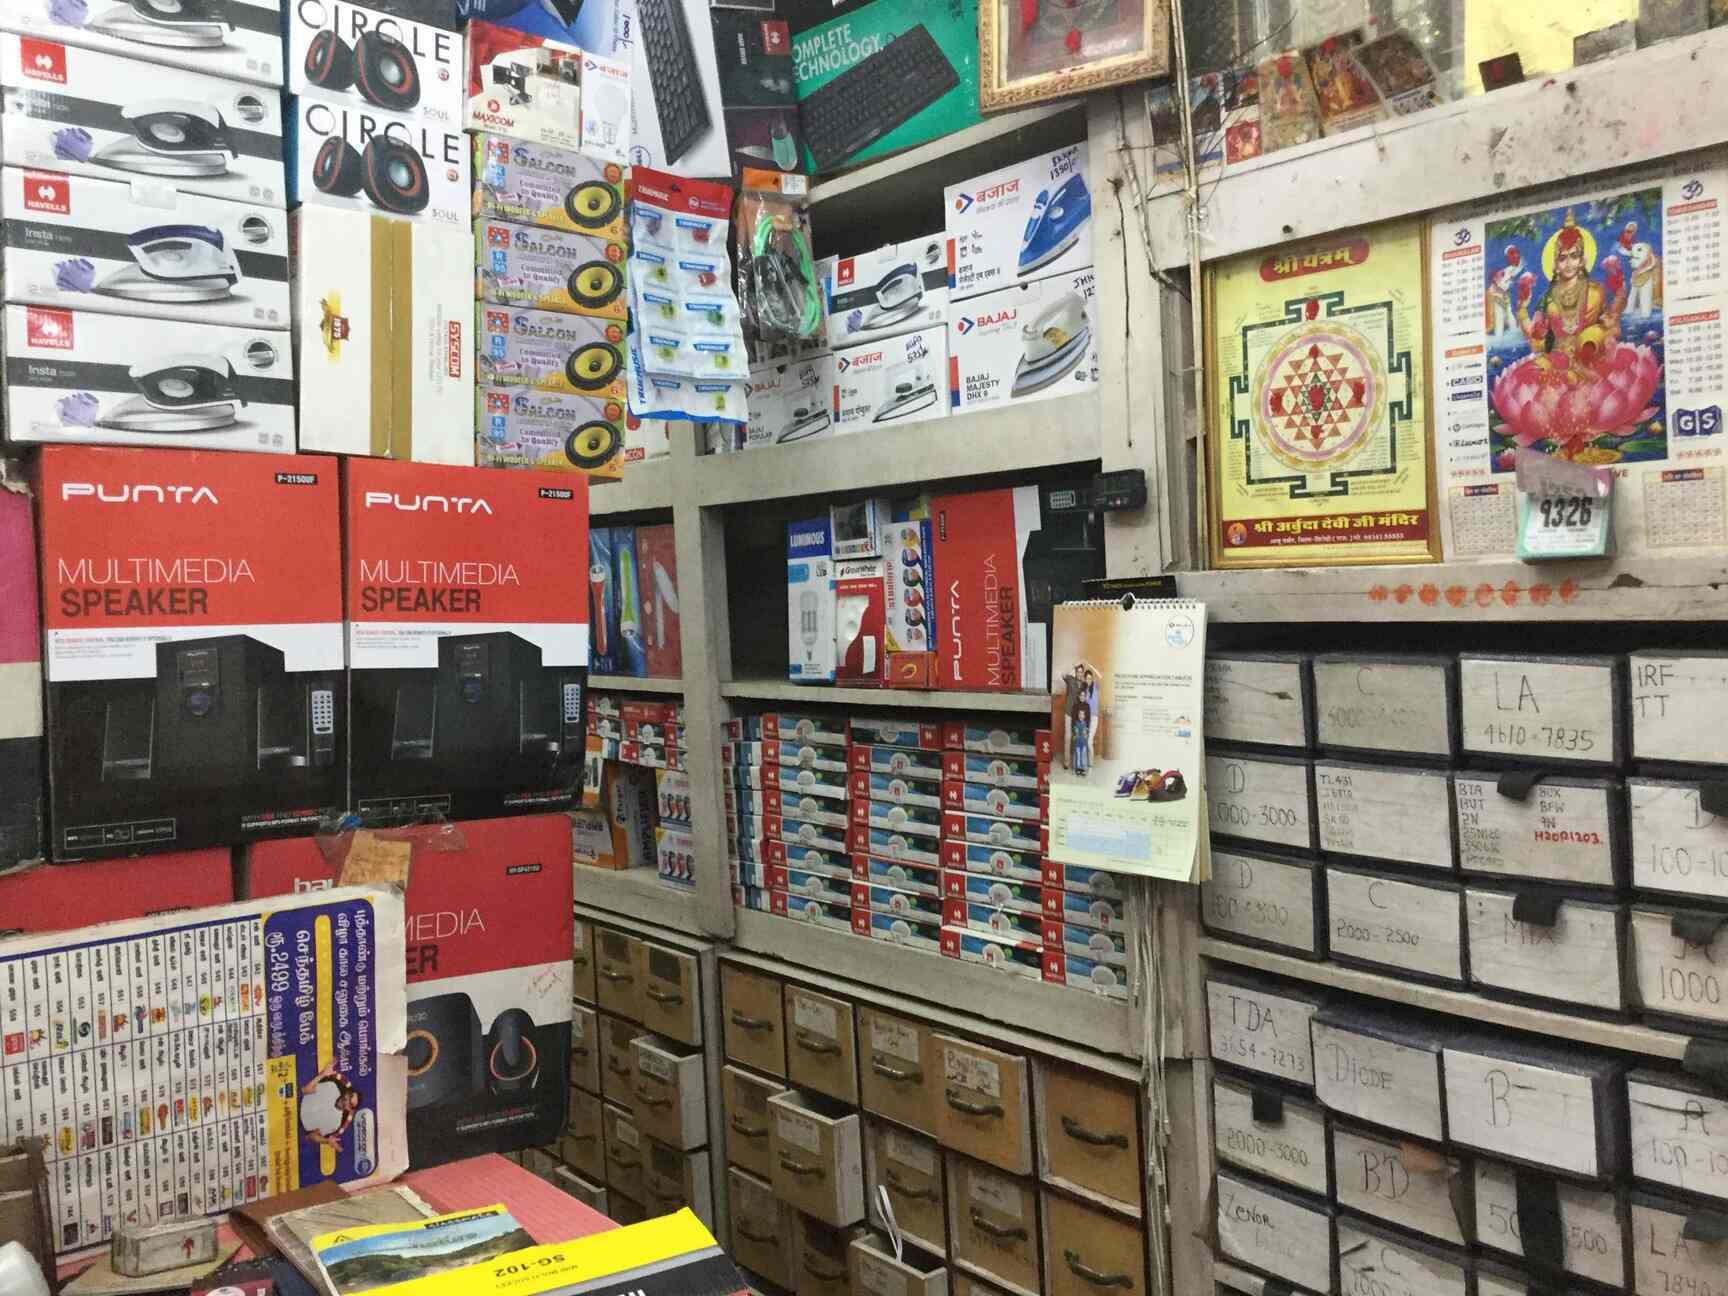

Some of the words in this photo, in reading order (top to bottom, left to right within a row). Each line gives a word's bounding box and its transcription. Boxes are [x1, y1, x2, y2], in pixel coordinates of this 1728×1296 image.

[792, 23, 851, 64] OMPLETE
[27, 202, 67, 212] HAVELLS
[976, 309, 1017, 328] BAJAJ
[450, 321, 461, 377] SYSCOM
[966, 372, 990, 384] BAJAJ
[966, 378, 1000, 392] MAJESTY
[62, 483, 218, 504] PUNTA
[365, 491, 493, 515] PUNTA
[58, 558, 256, 585] MULTIMEDIA
[360, 559, 520, 585] MULTIMEDIA
[60, 587, 208, 617] SPEAKER
[361, 587, 481, 613] SPEAKER
[951, 580, 963, 681] PUNTA
[984, 552, 1001, 686] MULTIMEDIA
[1001, 585, 1016, 685] SPEAKER
[1637, 664, 1676, 688] IRF
[1494, 671, 1541, 714] LA
[1658, 964, 1721, 1005] 1000
[1228, 994, 1278, 1038] TDA
[493, 1253, 566, 1277] SG-102
